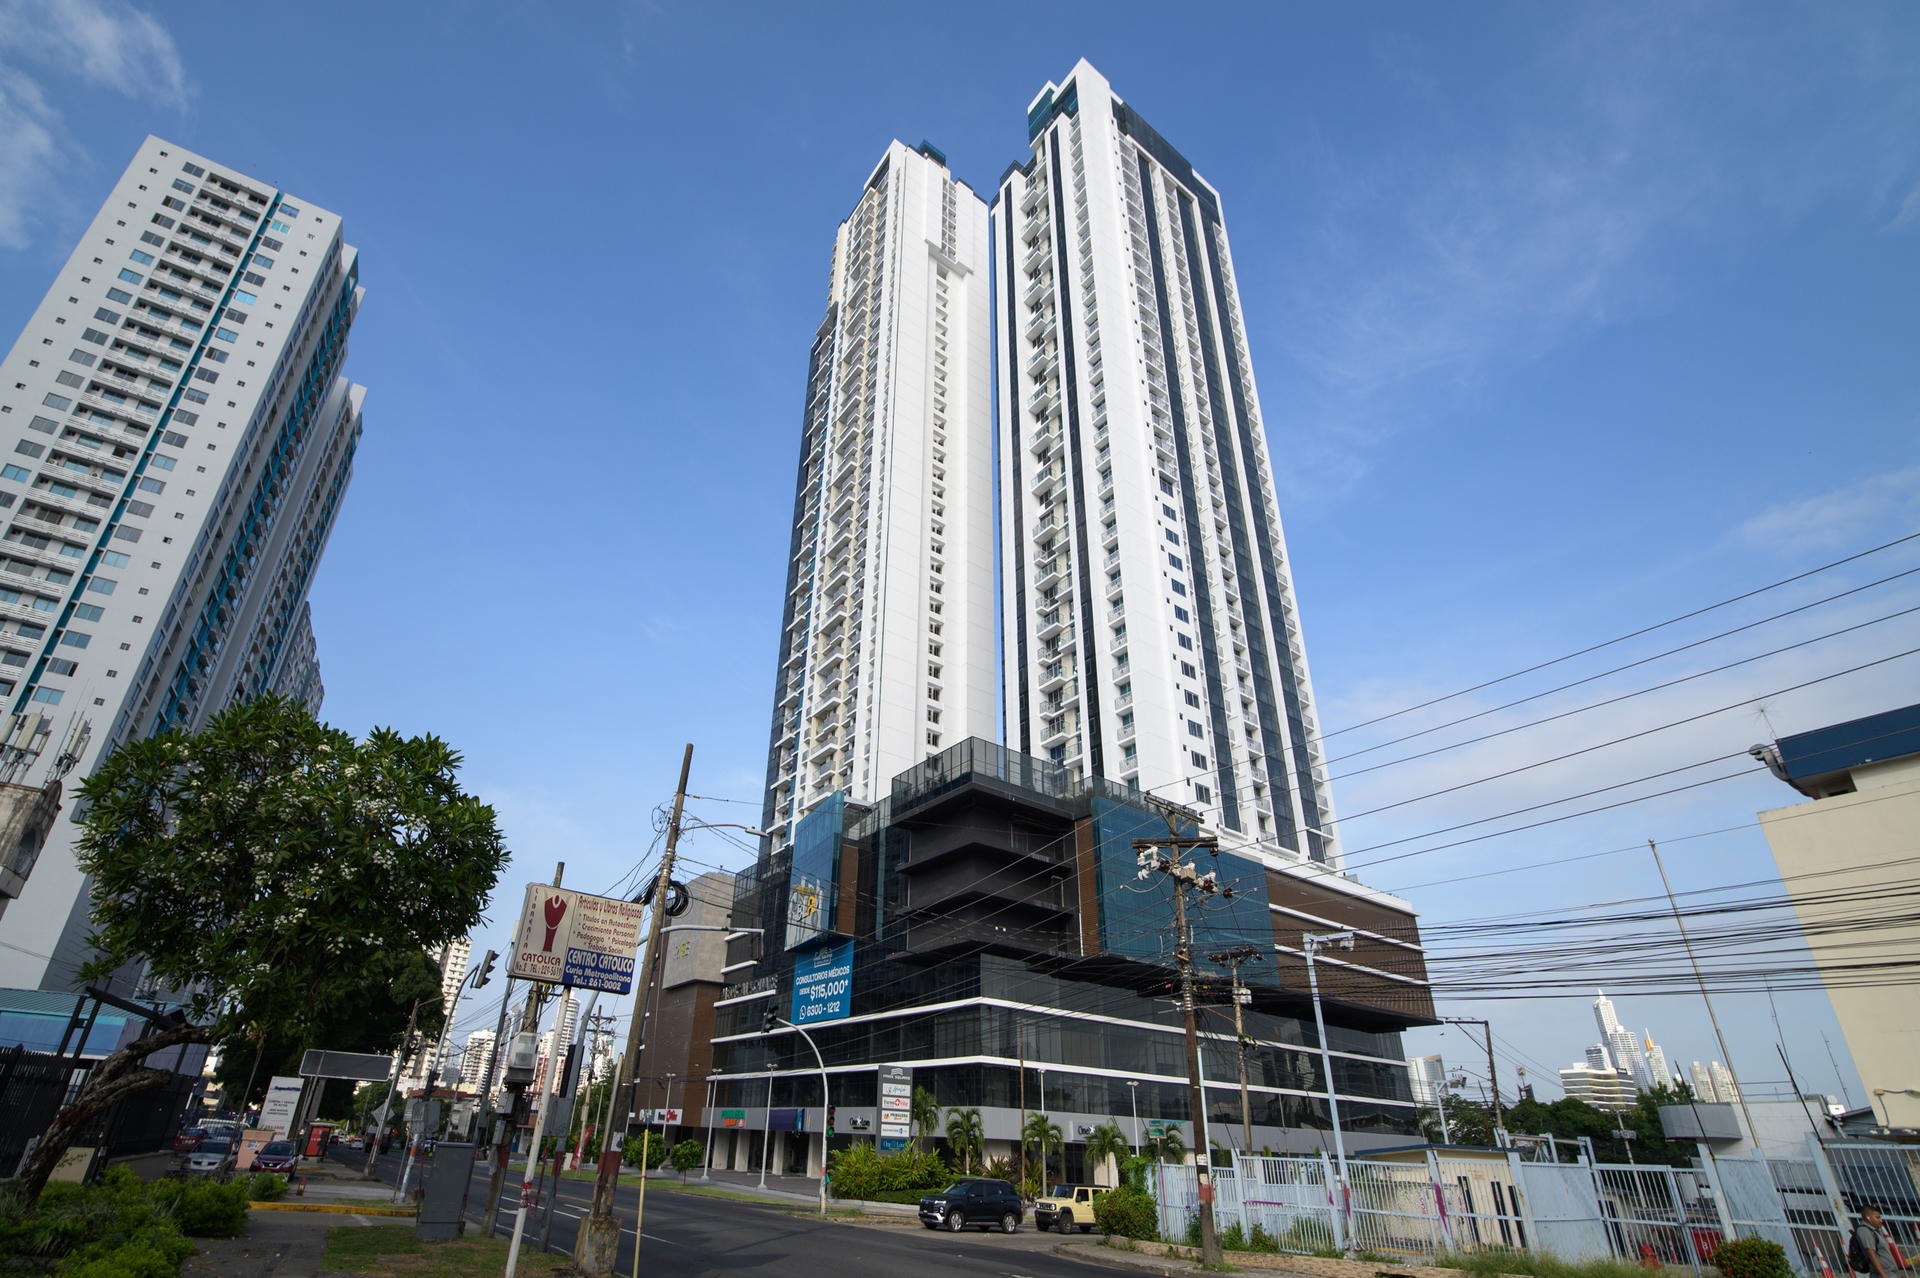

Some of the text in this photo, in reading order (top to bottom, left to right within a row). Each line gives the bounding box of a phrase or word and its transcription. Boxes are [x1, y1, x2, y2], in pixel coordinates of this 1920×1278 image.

[613, 929, 635, 938] Personal
[608, 946, 623, 954] Social
[521, 952, 561, 966] CATOLICA
[568, 949, 634, 973] CENTRO CATOLICO
[565, 965, 631, 983] Curia Metropolitana
[796, 965, 850, 986] CONSULTORIOS MÉDICOS
